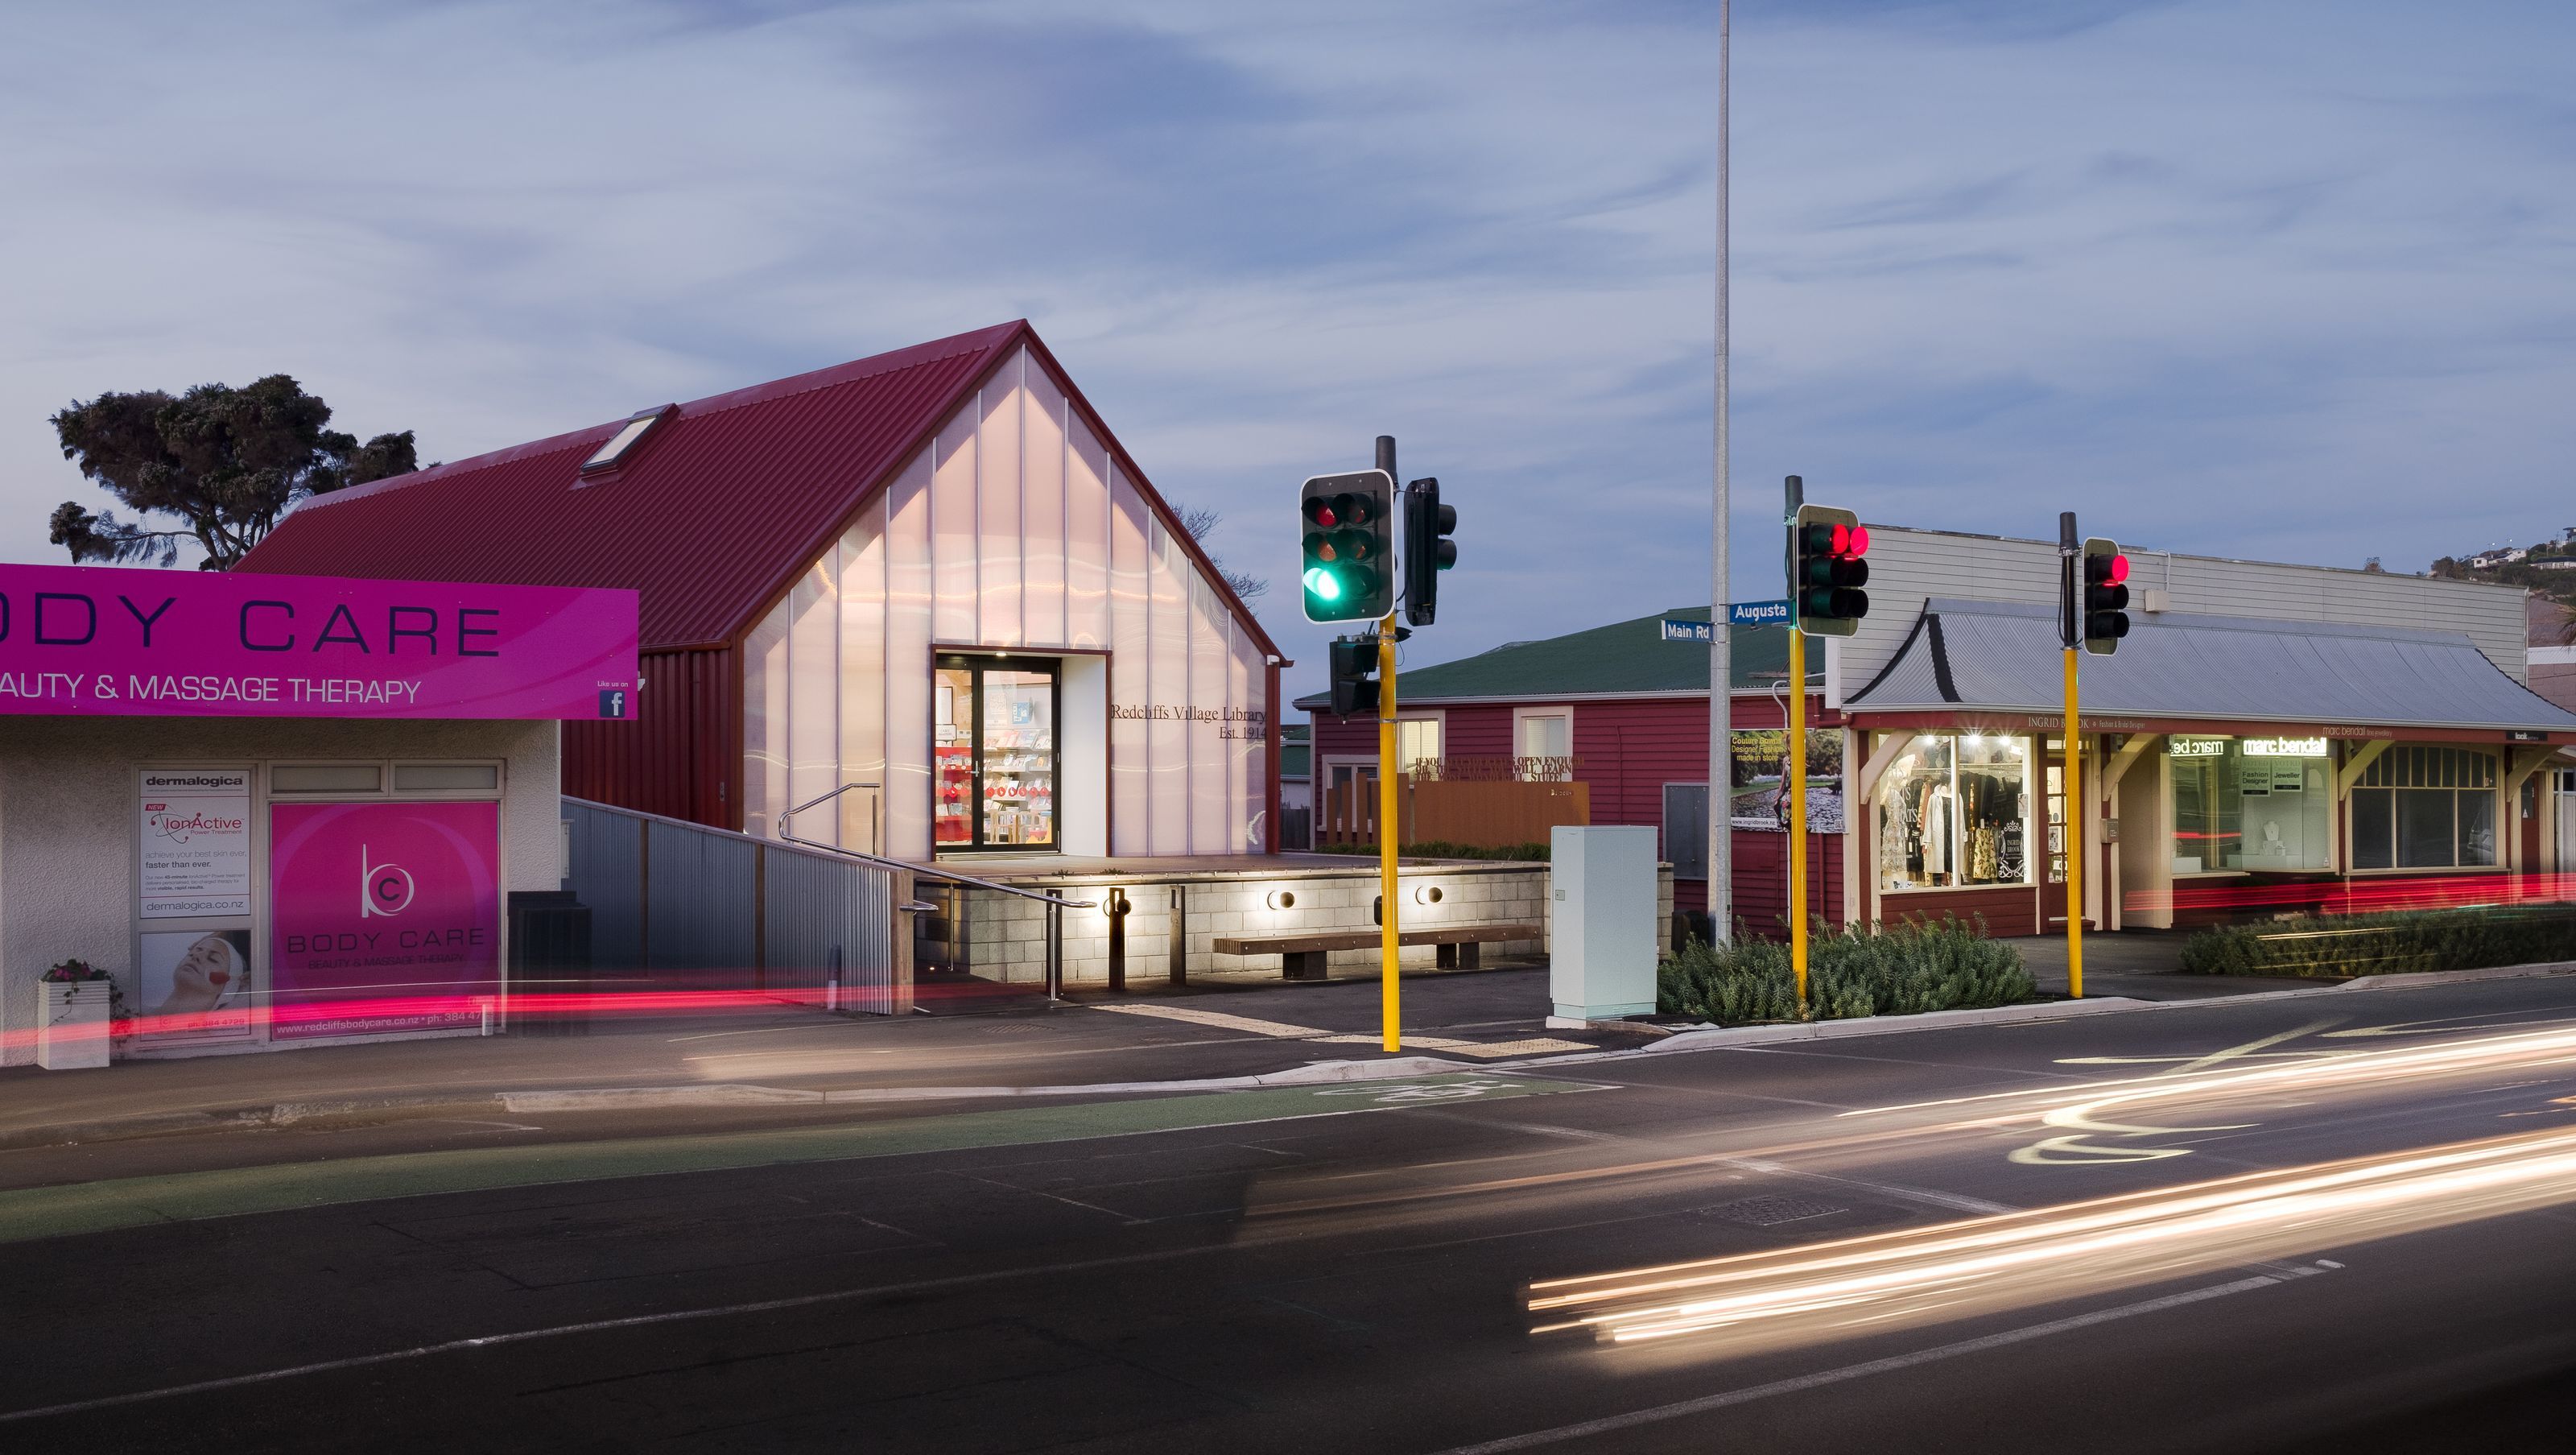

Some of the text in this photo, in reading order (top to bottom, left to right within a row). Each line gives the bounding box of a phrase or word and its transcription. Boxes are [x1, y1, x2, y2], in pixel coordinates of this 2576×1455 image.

[1736, 604, 1787, 622] Augusta
[240, 600, 499, 657] CARE
[1667, 624, 1710, 639] Main Rd
[94, 675, 119, 699] &
[129, 675, 279, 702] MASSAGE
[287, 678, 422, 704] THERAPY
[1112, 705, 1266, 725] Redcliffs Village Library
[2029, 717, 2058, 728] INGRID
[2061, 718, 2090, 729] BOK
[1219, 727, 1266, 738] Est. 1914
[2323, 726, 2341, 735] marc
[2341, 725, 2366, 736] bendall
[1732, 746, 1785, 754] Designer Fashion
[2243, 736, 2327, 754] marc bendall
[1517, 757, 1542, 766] OPEN
[1513, 766, 1534, 774] WILL
[1542, 765, 1572, 774] LEARN
[146, 776, 243, 787] dermalogica
[145, 851, 175, 859] achieve
[176, 851, 192, 859] your
[146, 861, 170, 869] faster
[146, 901, 244, 911] dermalogica.co.nz
[287, 928, 484, 954] BODY CARE
[308, 958, 349, 969] BEAUTY
[364, 956, 415, 967] MASSAGE
[418, 953, 464, 964] THERAPY
[276, 1016, 419, 1034] www.redcliffsbodycare.co.nz
[444, 1012, 465, 1022] 384
